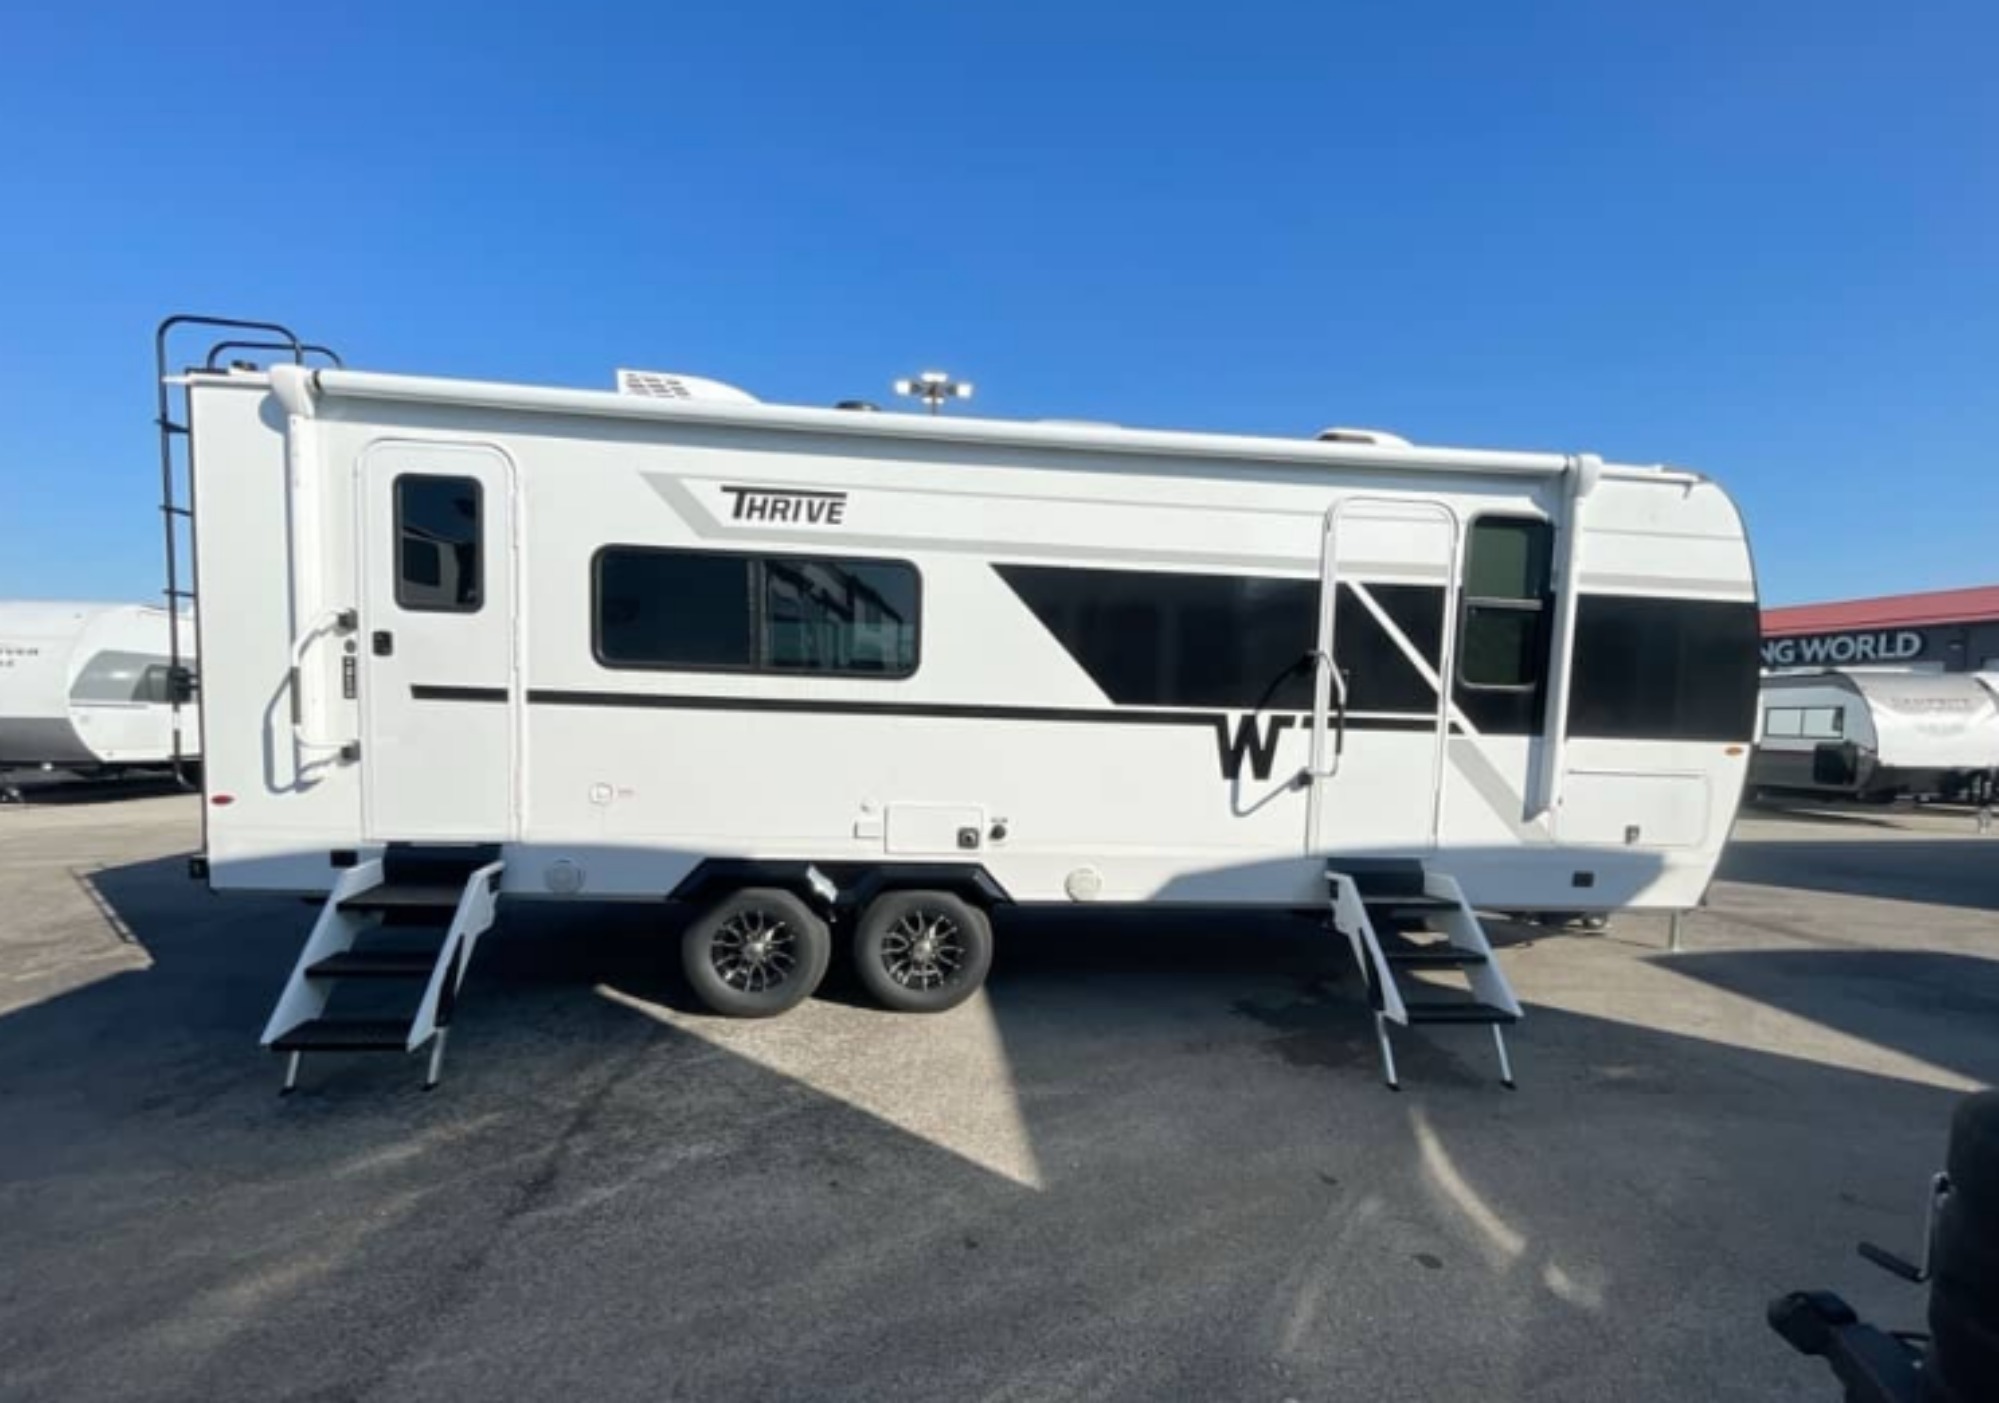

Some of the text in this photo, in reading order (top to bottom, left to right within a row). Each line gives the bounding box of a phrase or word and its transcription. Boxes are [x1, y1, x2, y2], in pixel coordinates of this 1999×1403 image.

[720, 485, 847, 525] THRIVE
[1801, 632, 1922, 662] WORLD
[1215, 713, 1283, 780] W
